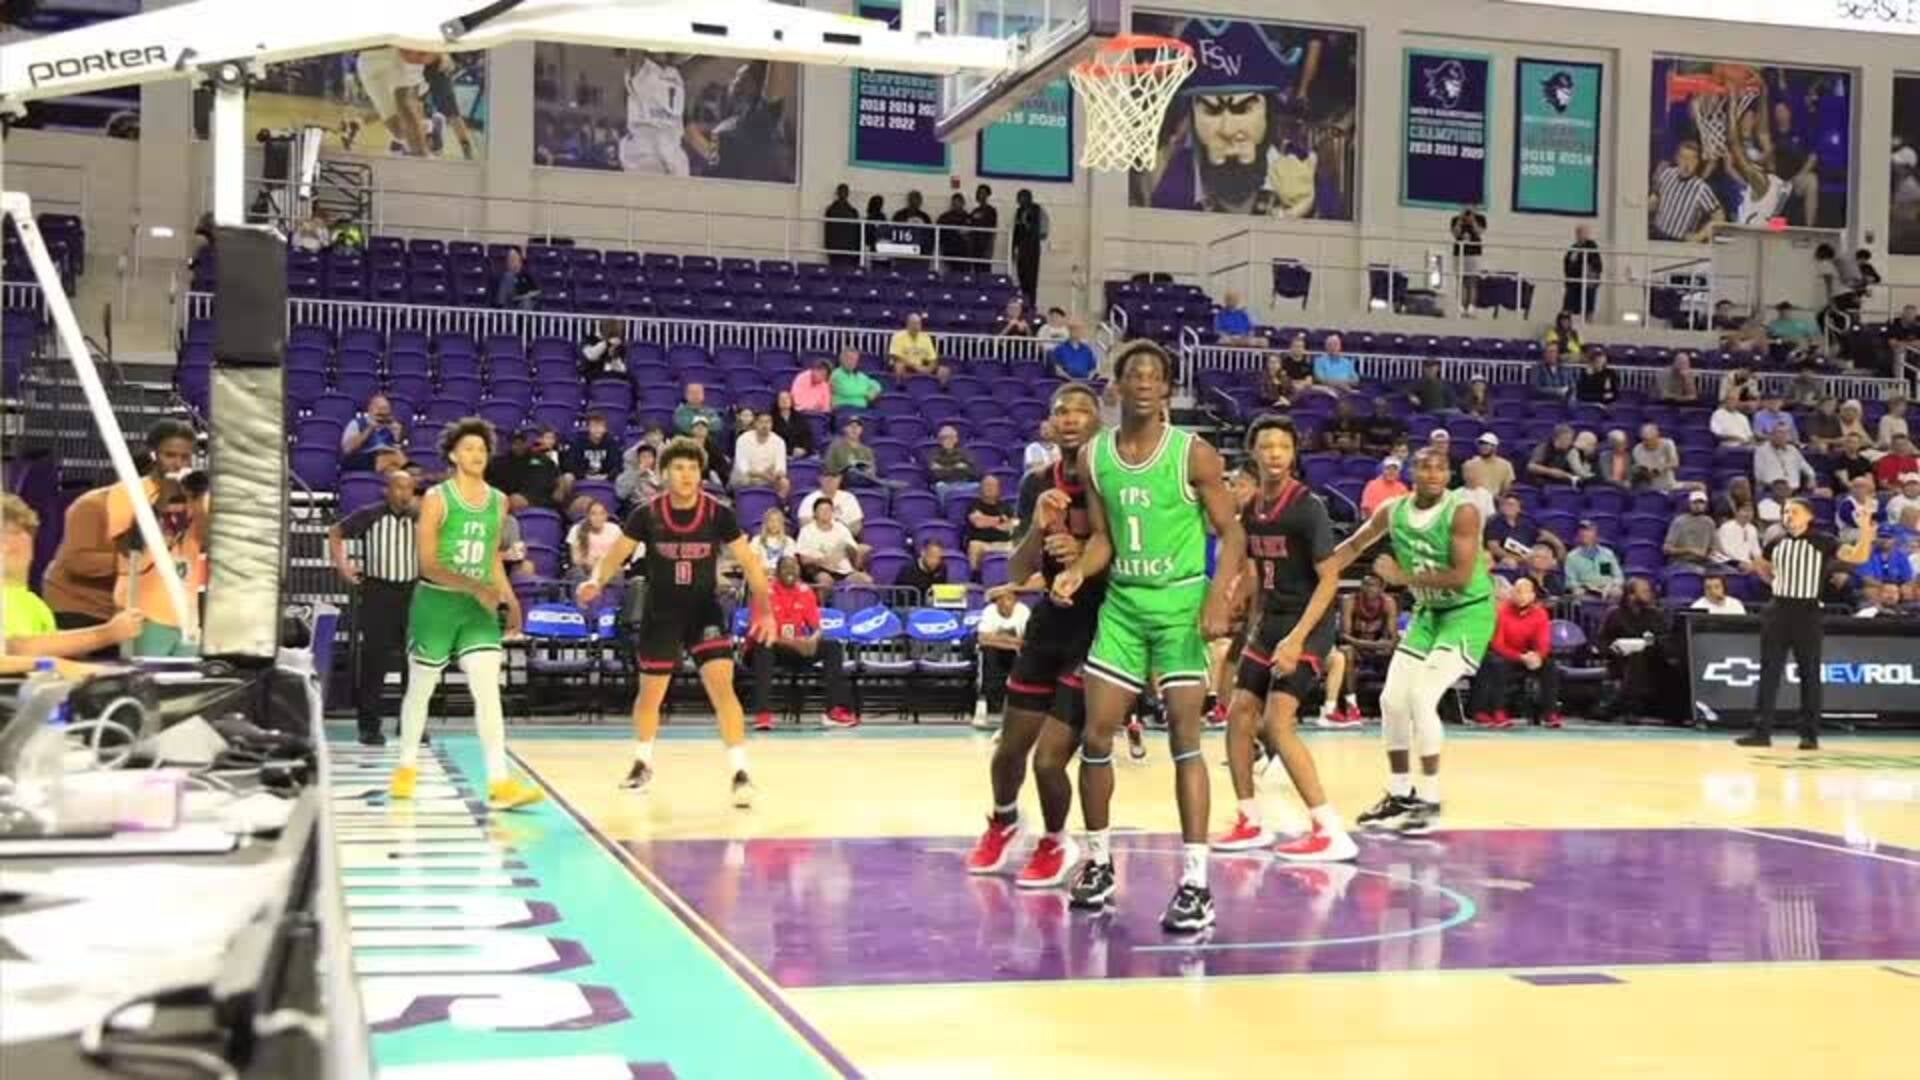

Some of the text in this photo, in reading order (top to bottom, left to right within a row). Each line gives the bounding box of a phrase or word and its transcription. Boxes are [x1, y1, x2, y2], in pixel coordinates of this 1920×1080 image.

[1198, 38, 1243, 76] FSW
[861, 84, 937, 100] CHAMPION
[860, 98, 886, 113] 2018
[888, 101, 915, 115] 2019
[859, 113, 916, 131] 2021 2022
[1027, 113, 1068, 129] 2020
[891, 229, 913, 242] 116
[1127, 514, 1142, 552] 1
[452, 539, 486, 564] 30
[1785, 662, 1920, 685] CEVROL
